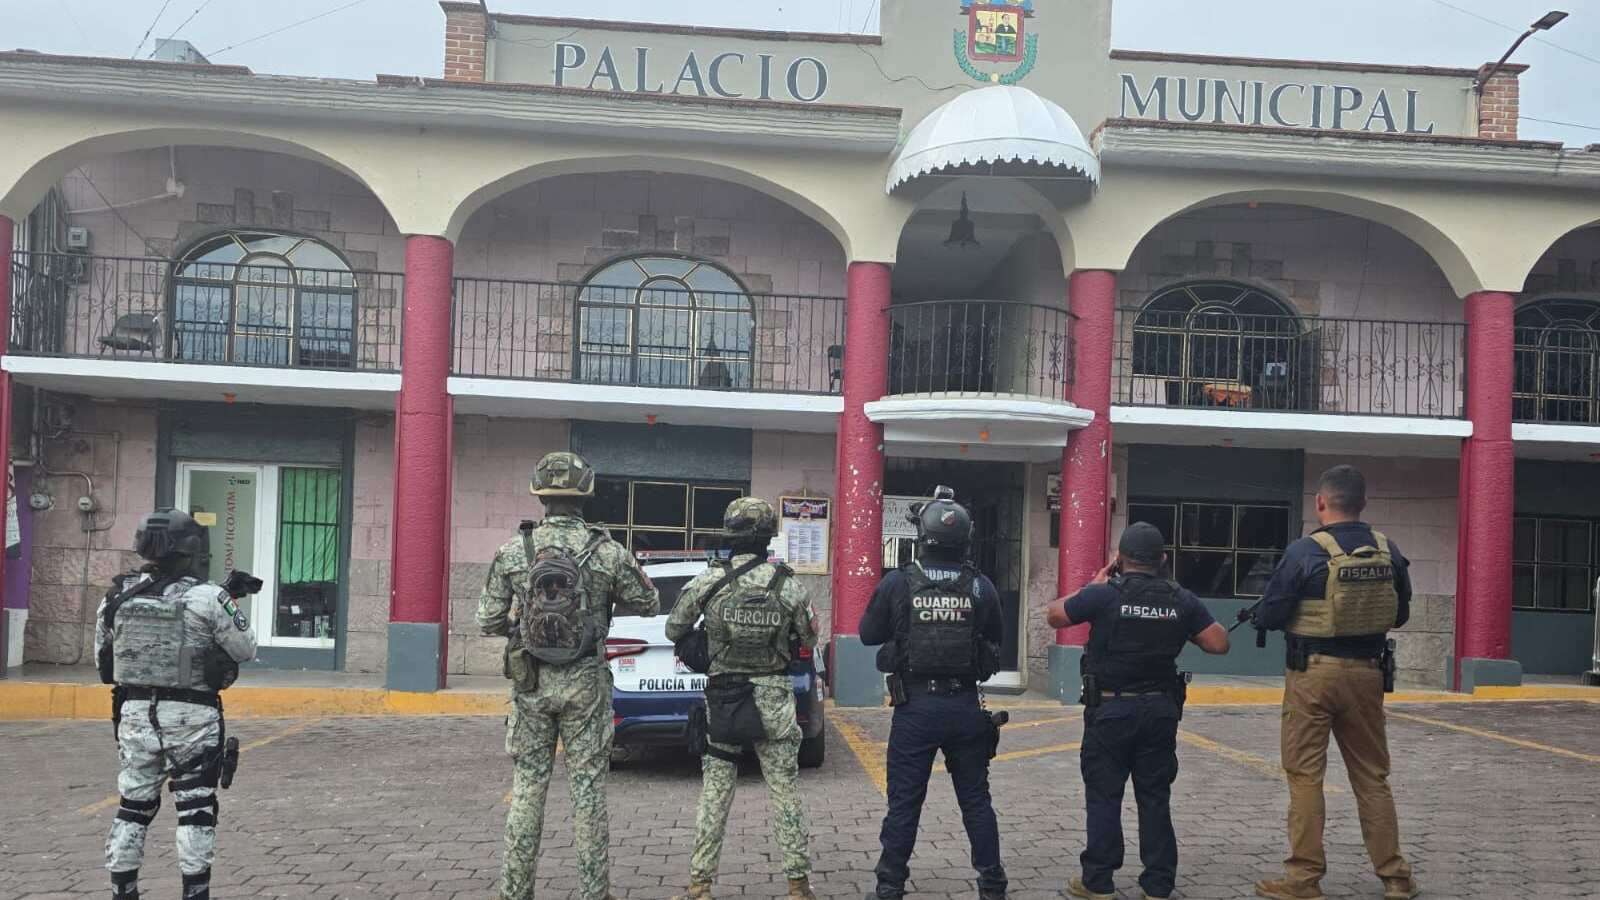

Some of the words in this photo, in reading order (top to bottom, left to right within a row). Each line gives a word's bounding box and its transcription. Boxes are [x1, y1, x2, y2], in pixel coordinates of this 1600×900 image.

[555, 43, 828, 102] PALACIO
[1119, 73, 1435, 135] MUNICIPAL
[1340, 567, 1392, 578] FISCALIA
[912, 597, 972, 609] GUARDIA
[919, 611, 966, 621] CIVIL
[1121, 605, 1177, 618] FISCALIA
[690, 678, 710, 690] MU
